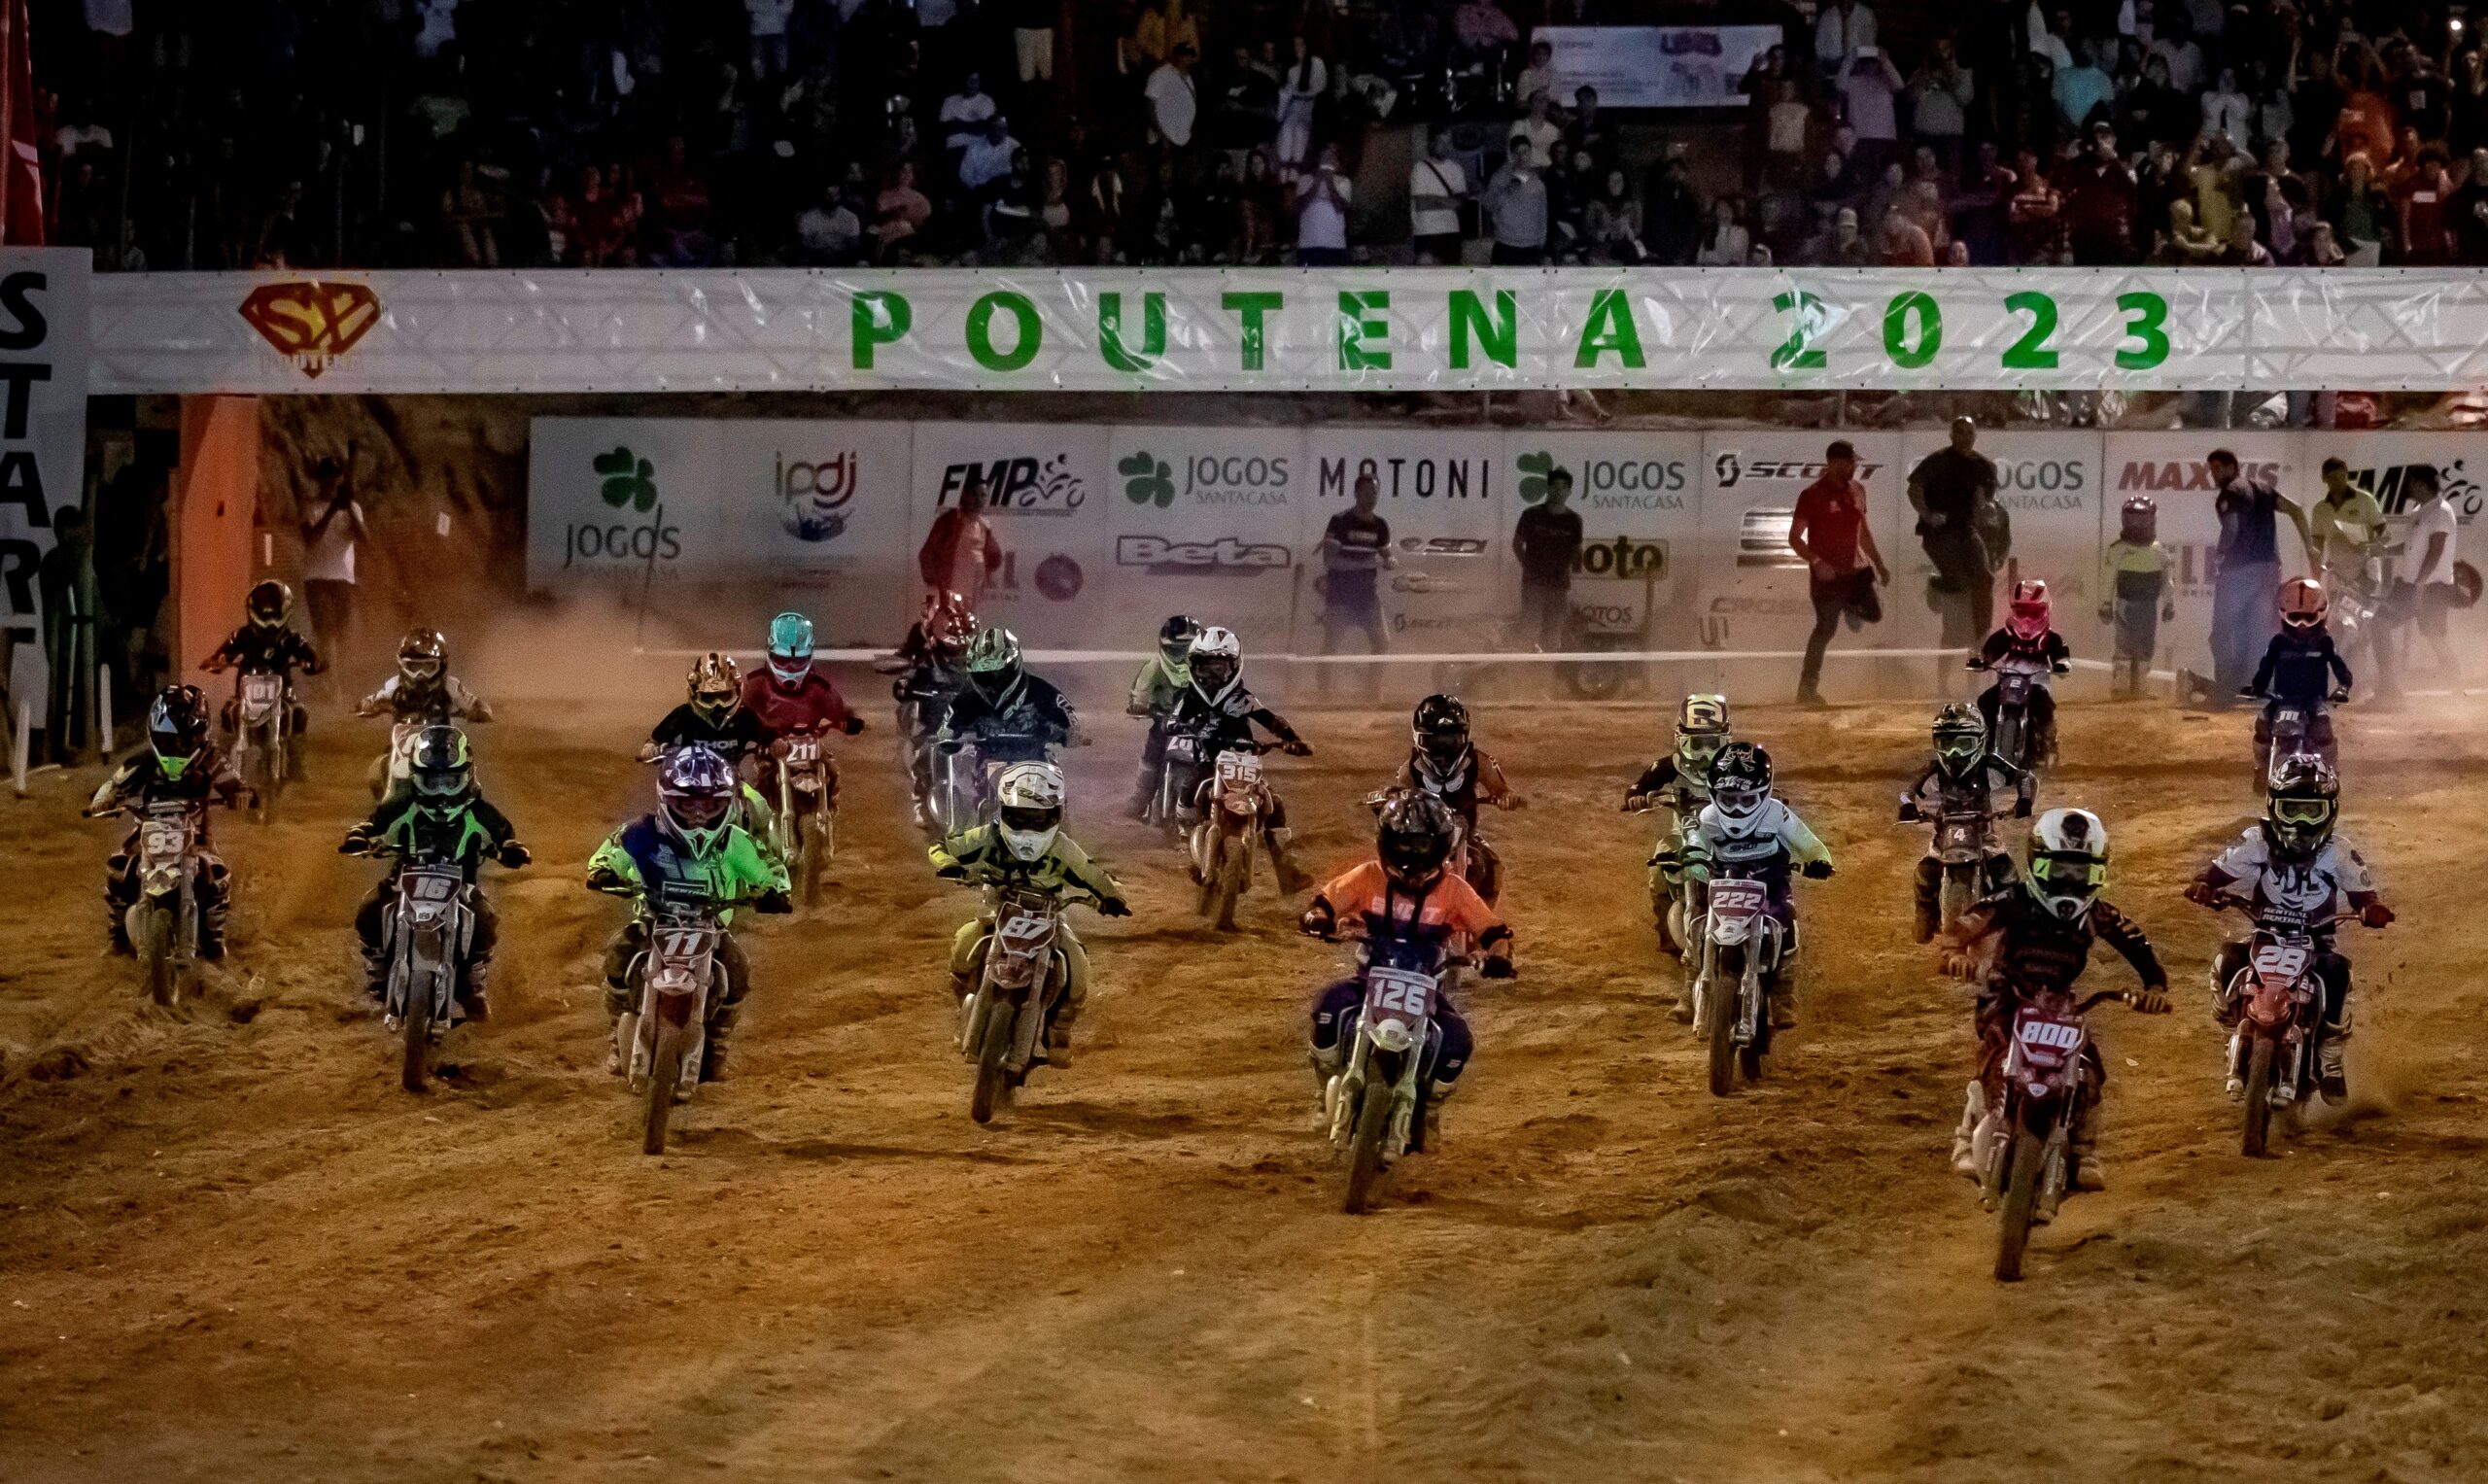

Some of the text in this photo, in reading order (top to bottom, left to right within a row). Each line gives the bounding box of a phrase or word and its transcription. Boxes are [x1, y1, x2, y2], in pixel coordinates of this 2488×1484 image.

[851, 289, 2172, 372] POUTENA 2023
[1184, 456, 1290, 496] JOGOS
[1580, 460, 1686, 500] JOGOS
[1196, 489, 1289, 506] SANTACASA
[1593, 496, 1685, 509] SANTACASA
[563, 524, 680, 569] JOGOS
[1117, 535, 1292, 569] Beta
[786, 742, 817, 762] 211
[1223, 764, 1257, 782] 315
[148, 831, 186, 855] 93
[412, 877, 452, 899] 16
[1712, 891, 1762, 910] 222
[663, 931, 703, 956] 11
[2255, 945, 2306, 977] 28
[1372, 979, 1427, 1016] 126
